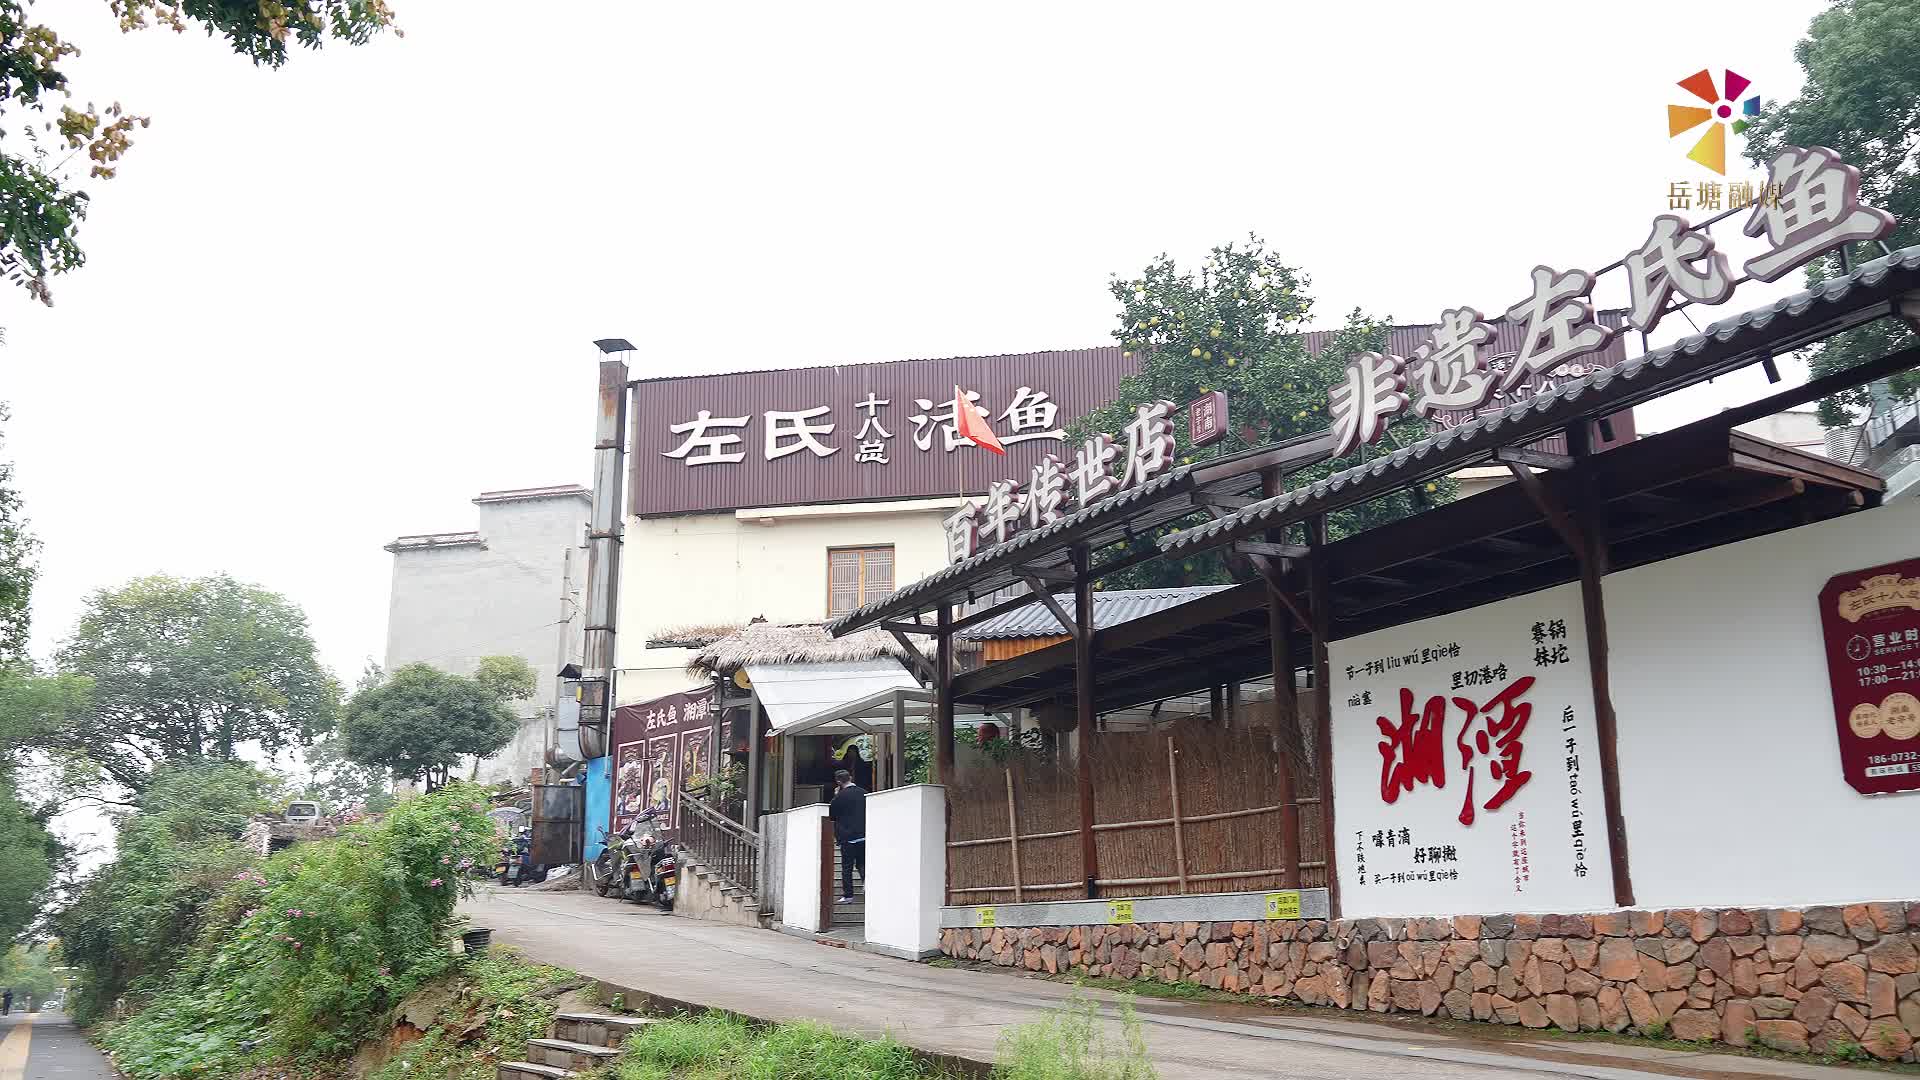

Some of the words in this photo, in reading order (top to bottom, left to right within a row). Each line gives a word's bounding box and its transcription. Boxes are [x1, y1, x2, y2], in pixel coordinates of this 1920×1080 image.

[1328, 145, 1896, 457] 非遗左氏鱼
[661, 405, 842, 466] 左氏
[854, 392, 896, 465] 十八总
[943, 400, 1176, 565] 百年传世店
[1874, 643, 1913, 655] SERVICE
[645, 705, 678, 732] 左氏鱼
[1377, 676, 1536, 826] 湘潭
